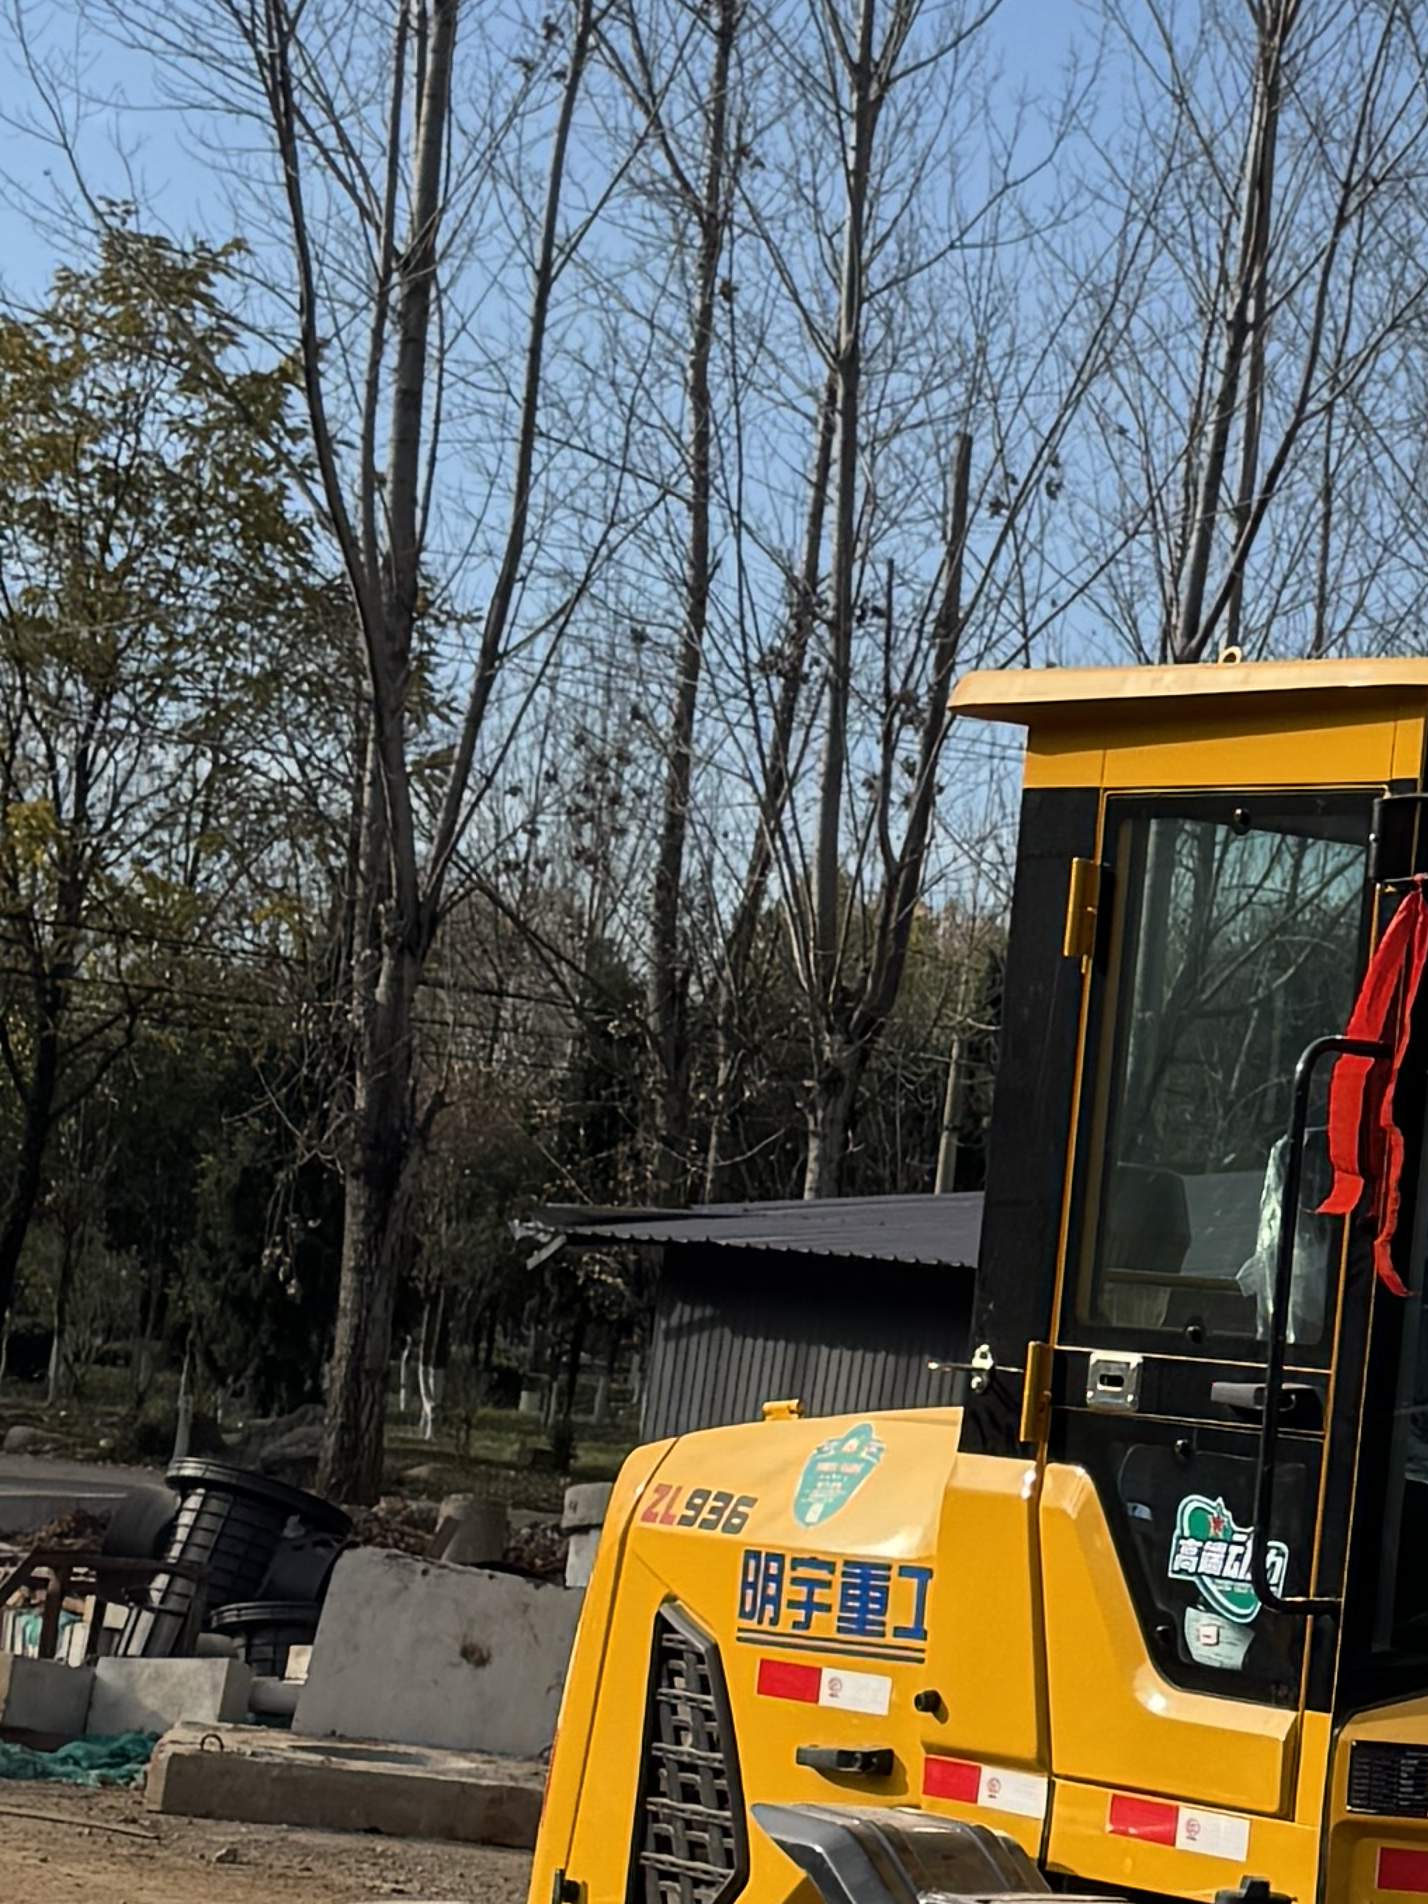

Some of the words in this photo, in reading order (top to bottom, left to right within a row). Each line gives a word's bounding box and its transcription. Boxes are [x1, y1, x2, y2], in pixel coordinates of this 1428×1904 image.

[640, 1483, 759, 1535] ZL936
[738, 1549, 934, 1641] 明宇重工
